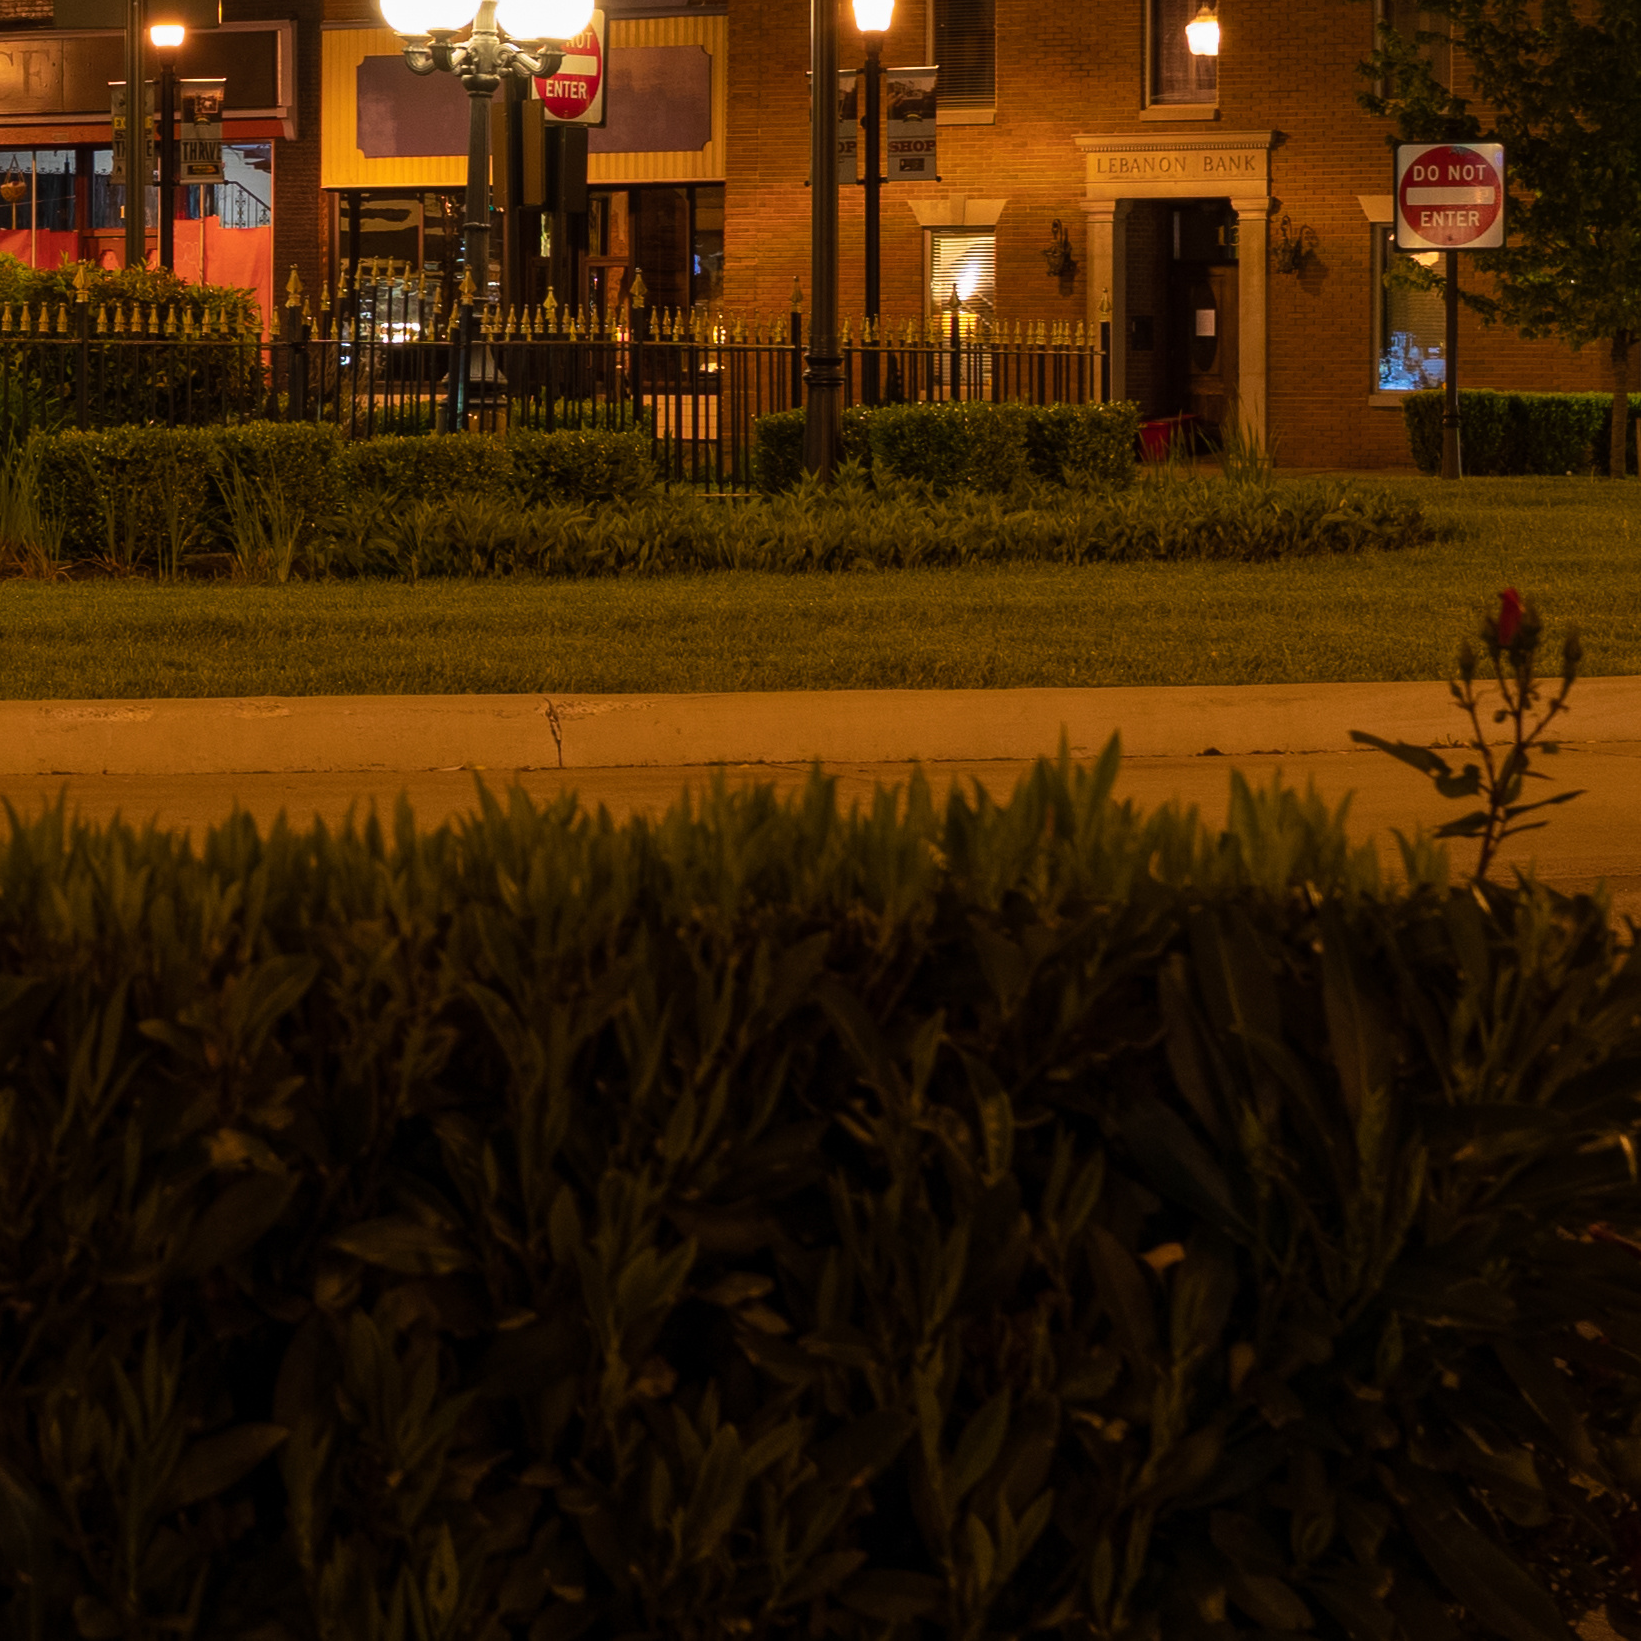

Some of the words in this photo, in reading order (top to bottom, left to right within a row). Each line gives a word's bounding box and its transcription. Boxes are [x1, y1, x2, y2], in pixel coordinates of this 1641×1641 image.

[545, 79, 588, 100] ENTER
[888, 140, 936, 153] SHOP
[1096, 157, 1188, 174] LEBANON
[1203, 155, 1258, 173] BANK
[1413, 165, 1439, 182] DO
[1448, 165, 1486, 182] NOT
[1420, 211, 1480, 227] ENTER
